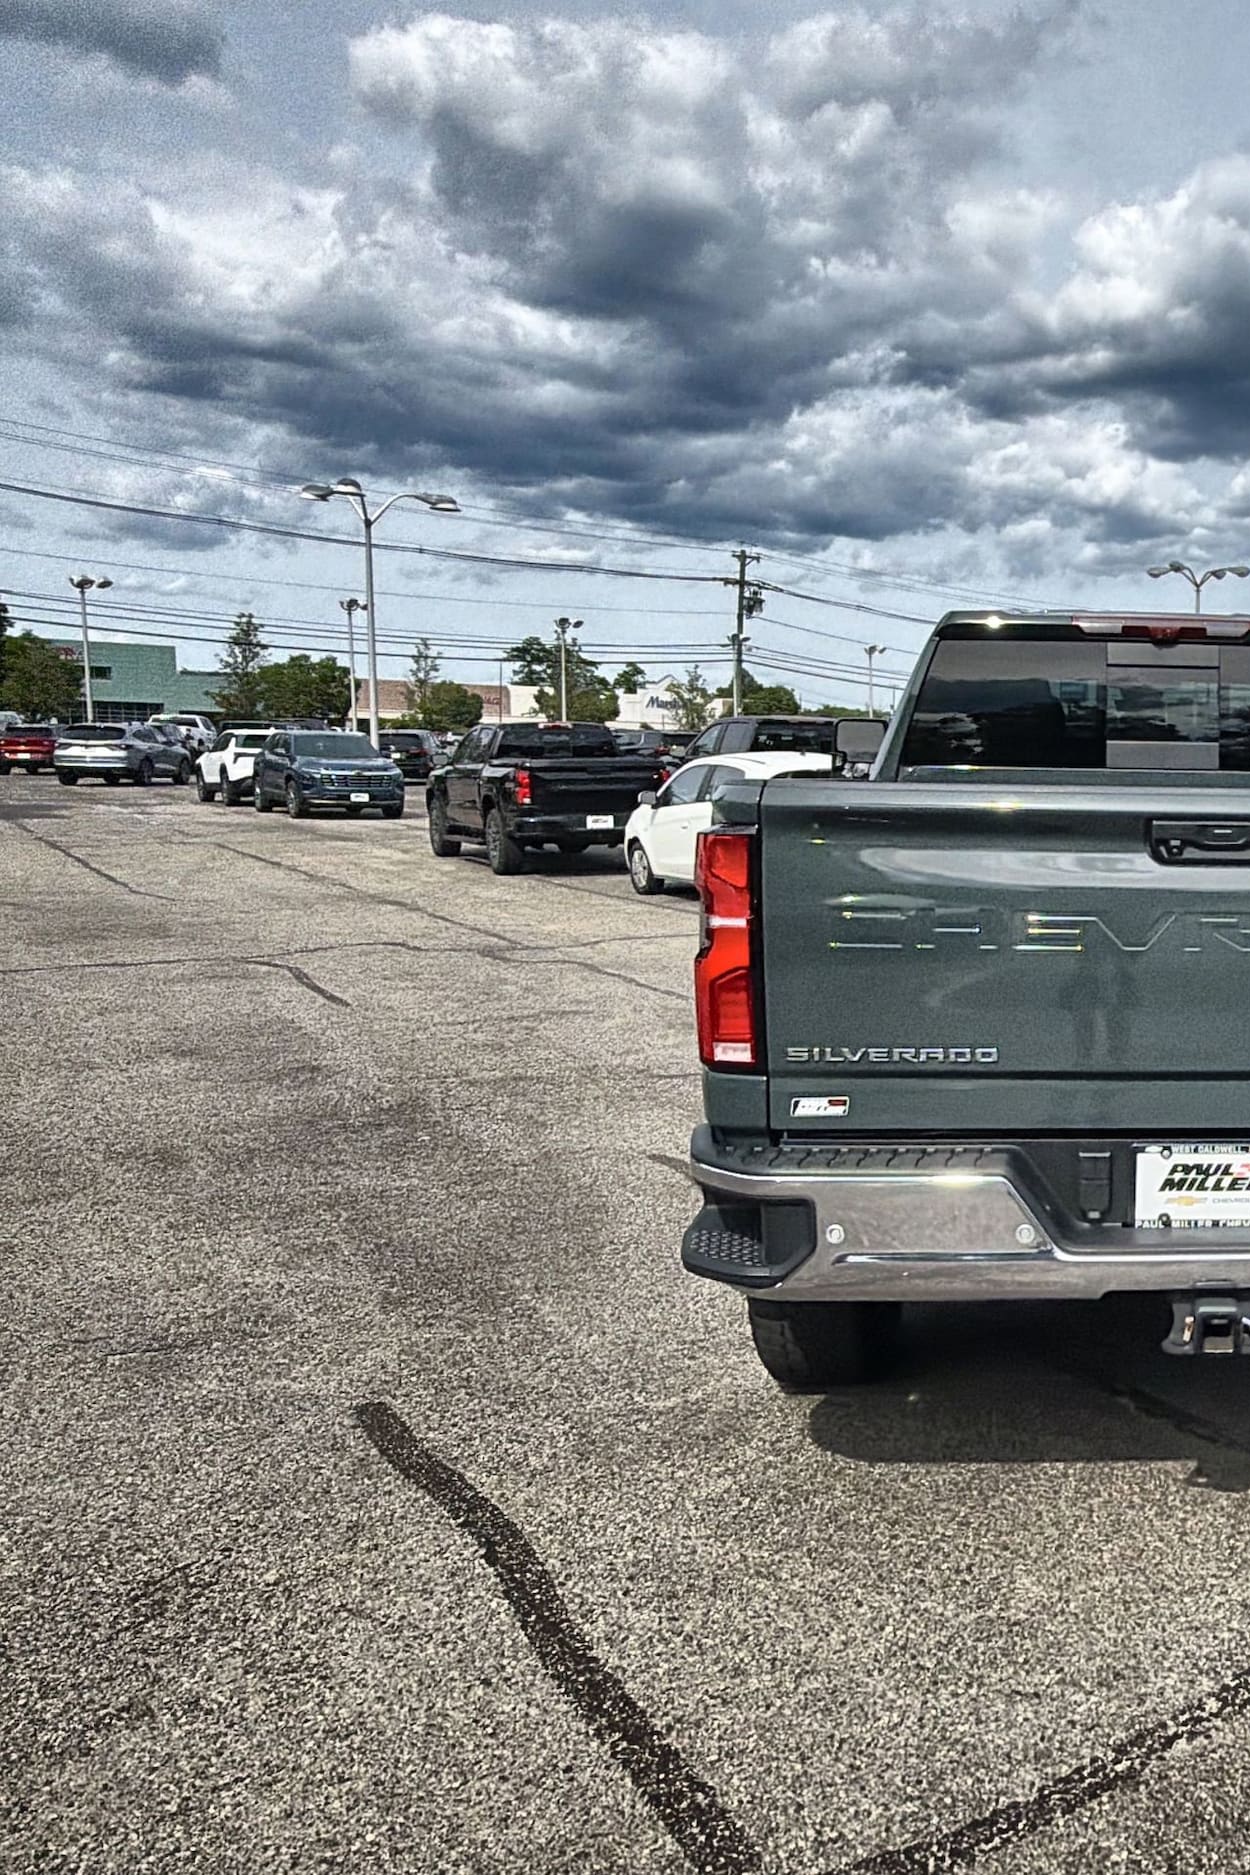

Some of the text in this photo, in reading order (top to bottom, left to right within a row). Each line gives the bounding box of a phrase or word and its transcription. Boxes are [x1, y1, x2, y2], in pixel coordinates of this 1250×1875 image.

[785, 1047, 999, 1063] SILVERADO
[1171, 1144, 1195, 1155] WEST
[1167, 1163, 1235, 1177] PAUL
[1135, 1219, 1163, 1229] PAUL
[1171, 1219, 1213, 1229] MILLER
